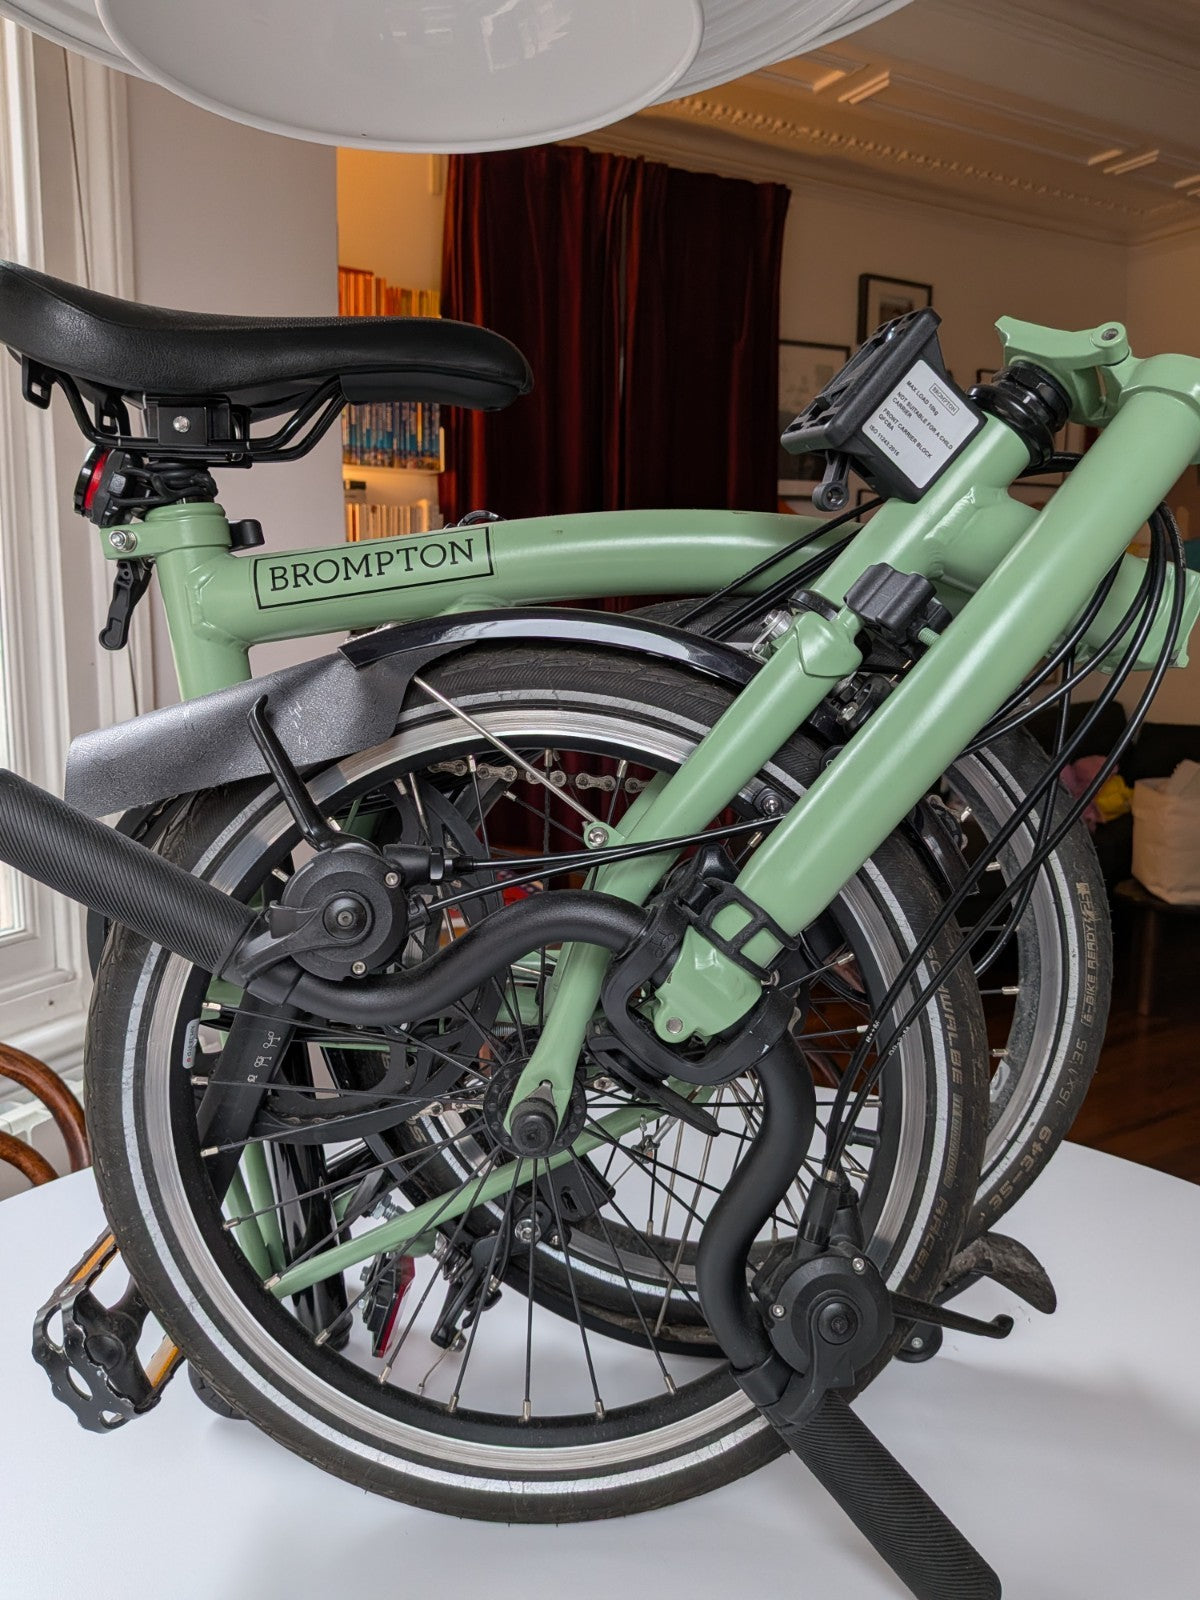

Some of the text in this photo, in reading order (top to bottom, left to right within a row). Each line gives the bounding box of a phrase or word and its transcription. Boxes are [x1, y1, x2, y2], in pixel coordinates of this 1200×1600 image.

[892, 397, 912, 418] CARRIER
[906, 380, 917, 392] MAX
[916, 390, 929, 405] LOAD
[931, 386, 957, 413] BROMPTON
[869, 424, 879, 434] ISO
[883, 407, 933, 458] FRONT CARRIER BLOCK
[897, 391, 908, 402] NOT
[906, 401, 928, 424] SUITABLE
[926, 422, 937, 433] FOR
[939, 435, 953, 450] CHILD
[268, 537, 474, 592] BROMPTON
[1085, 922, 1097, 970] READY
